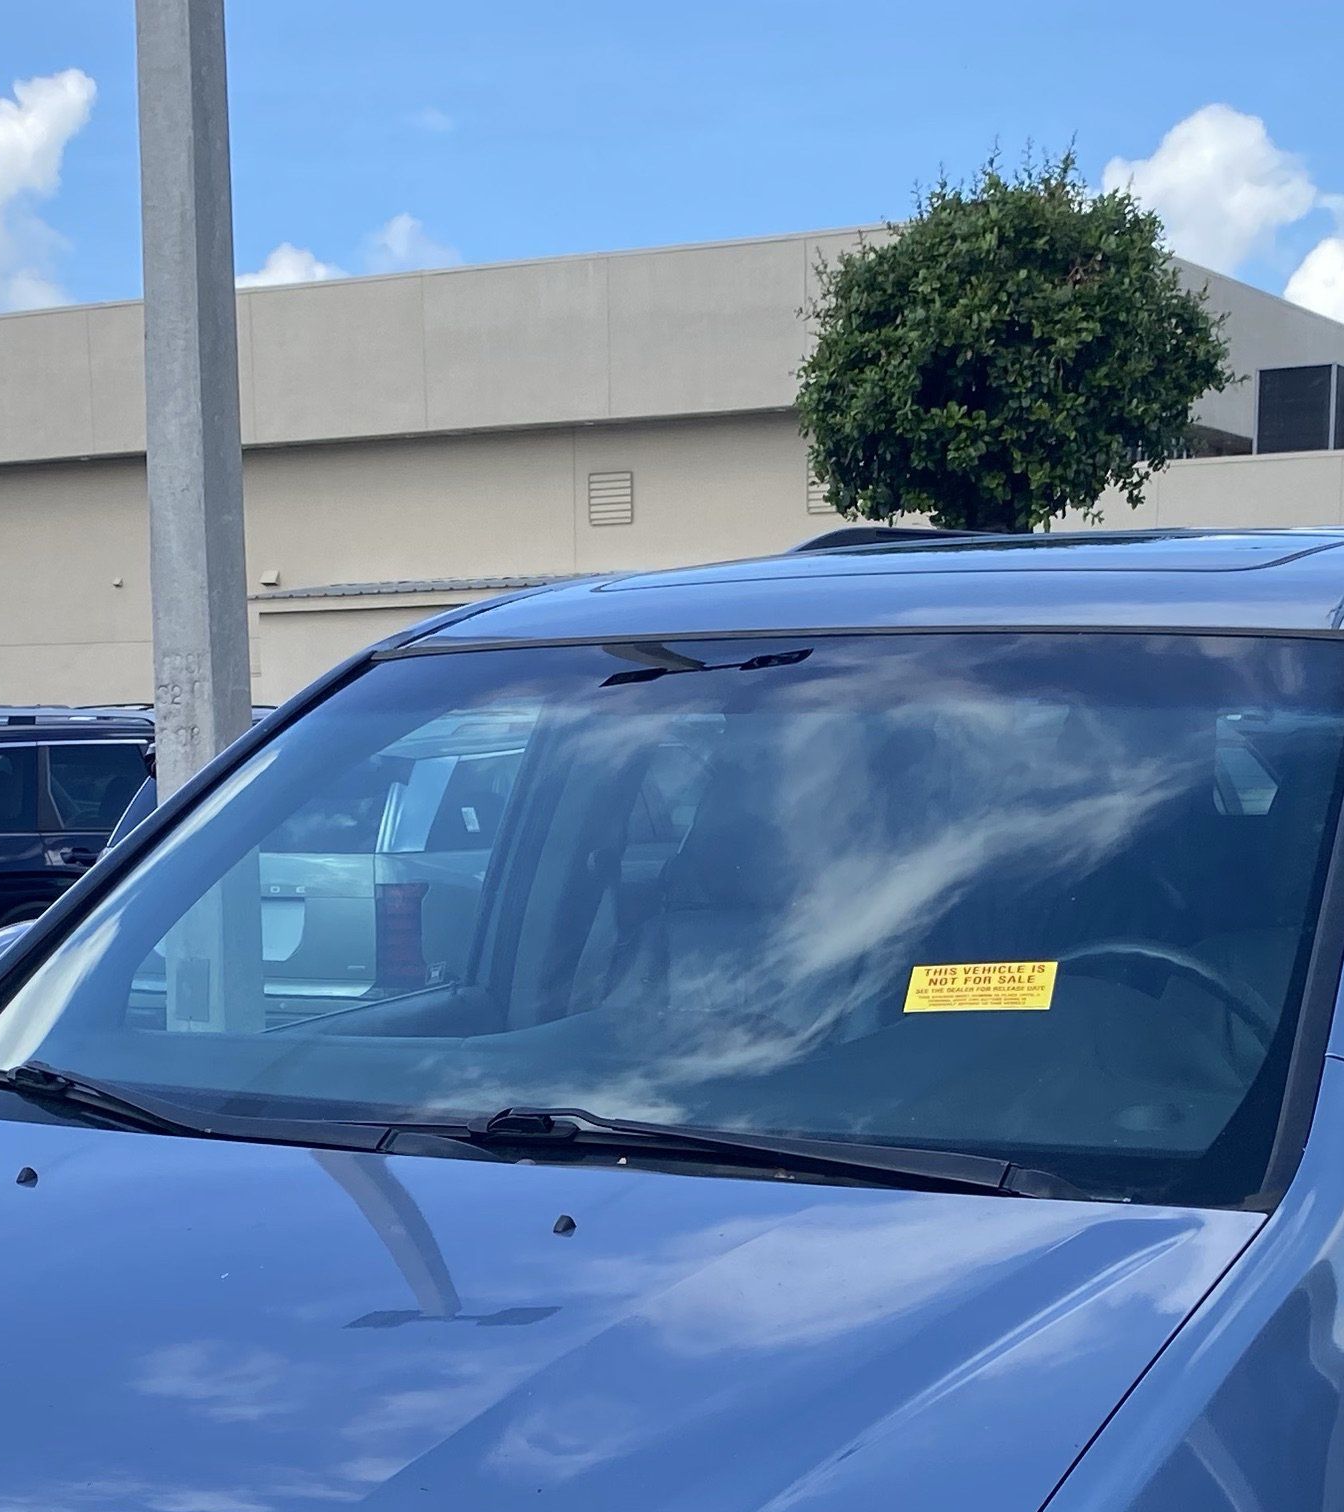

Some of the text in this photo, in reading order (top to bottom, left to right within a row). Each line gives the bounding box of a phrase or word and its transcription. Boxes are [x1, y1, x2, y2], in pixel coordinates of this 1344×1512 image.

[924, 964, 1046, 977] THIS VEHICLE IS
[928, 975, 1036, 986] NOT FOR SALE
